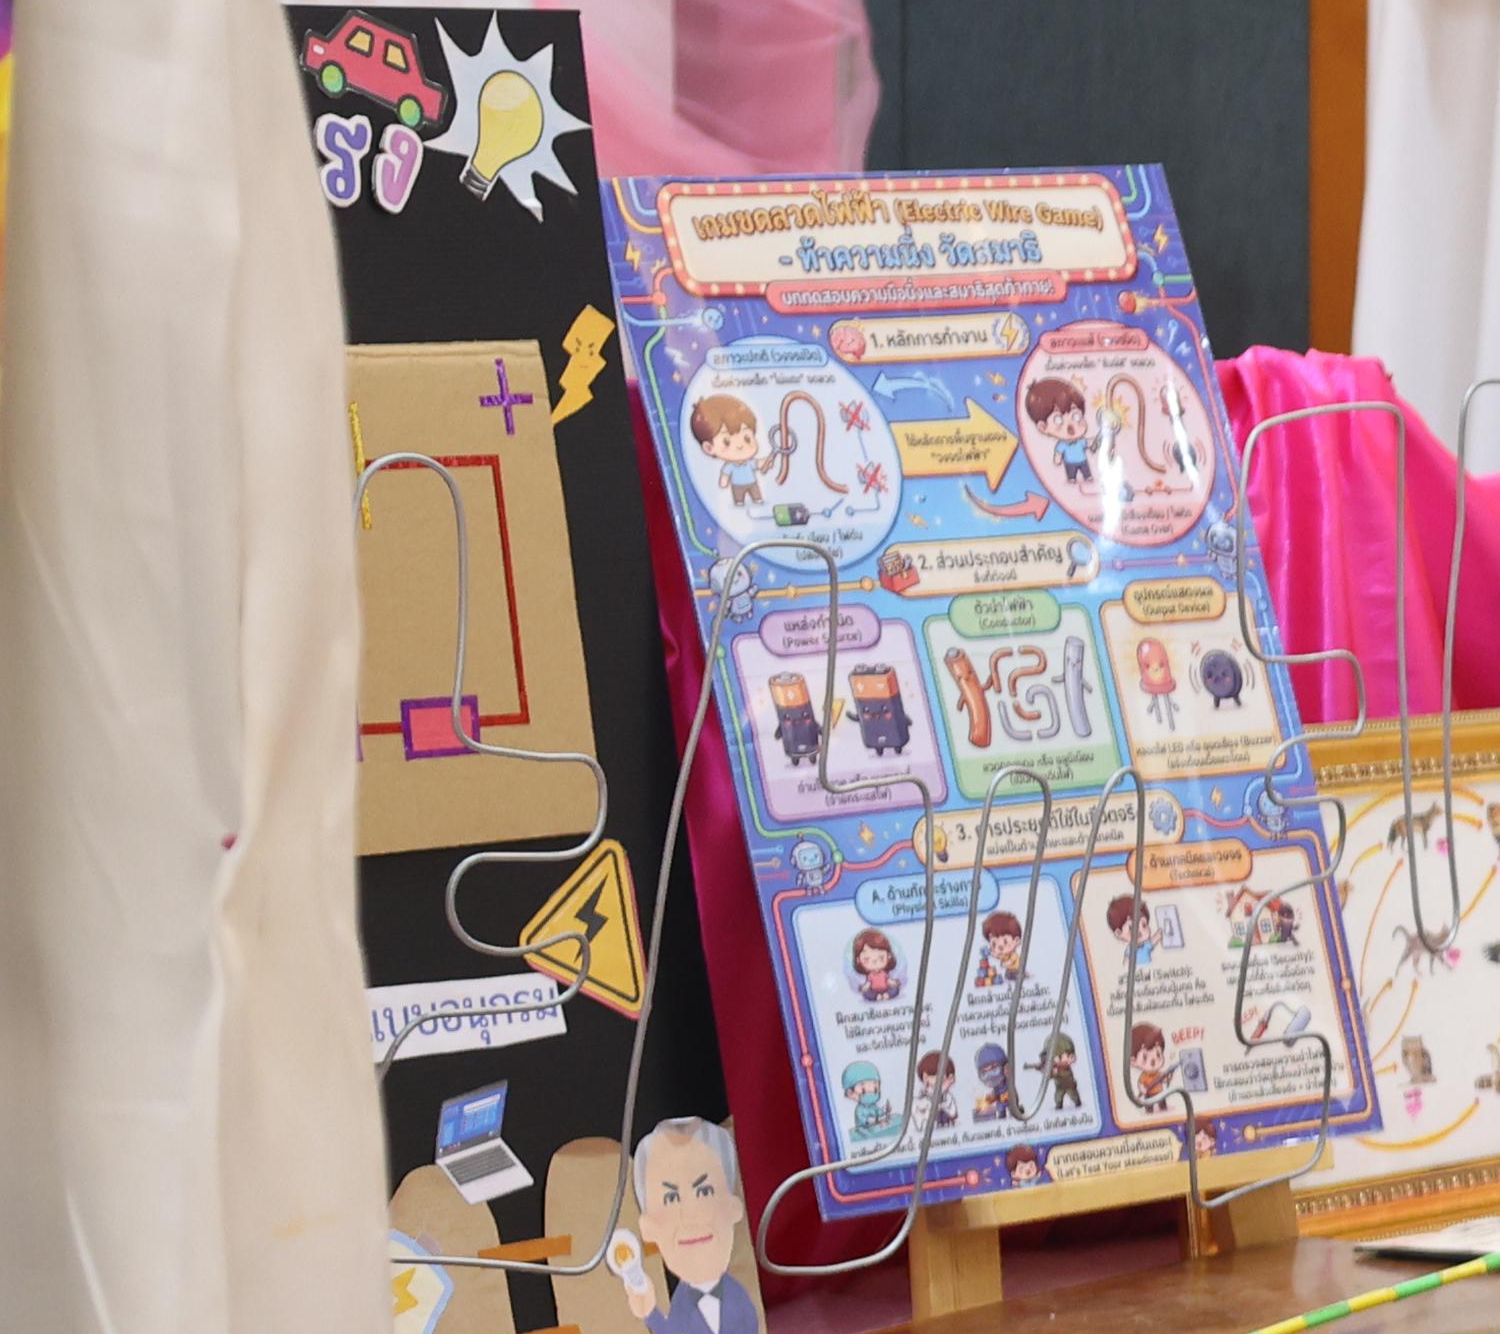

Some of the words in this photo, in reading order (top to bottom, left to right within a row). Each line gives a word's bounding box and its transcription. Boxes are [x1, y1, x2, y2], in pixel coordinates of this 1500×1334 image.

[691, 190, 890, 240] เกมขดลวดไฟฟ้า
[984, 199, 1032, 224] Wire
[1036, 202, 1104, 232] Game)
[939, 229, 1042, 267] วัดสมาธิ
[886, 326, 988, 349] หลักการทำงาน
[936, 542, 1064, 569] ส่วนประกอบสำคัญ
